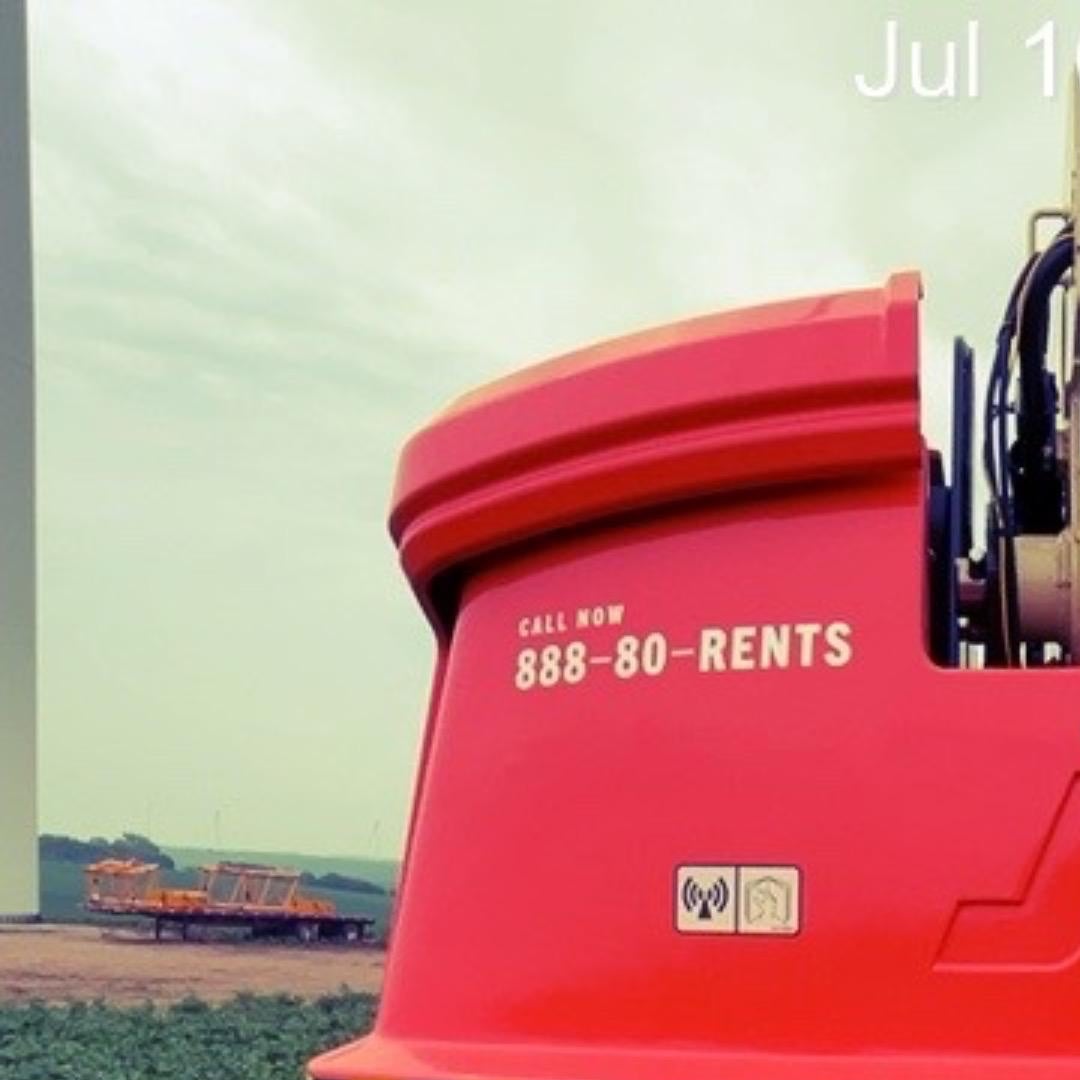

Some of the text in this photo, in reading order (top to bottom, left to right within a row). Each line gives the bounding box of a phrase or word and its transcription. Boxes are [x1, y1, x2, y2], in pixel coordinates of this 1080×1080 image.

[518, 604, 625, 637] CALL NOW
[514, 621, 853, 691] 888-80-RENTS
